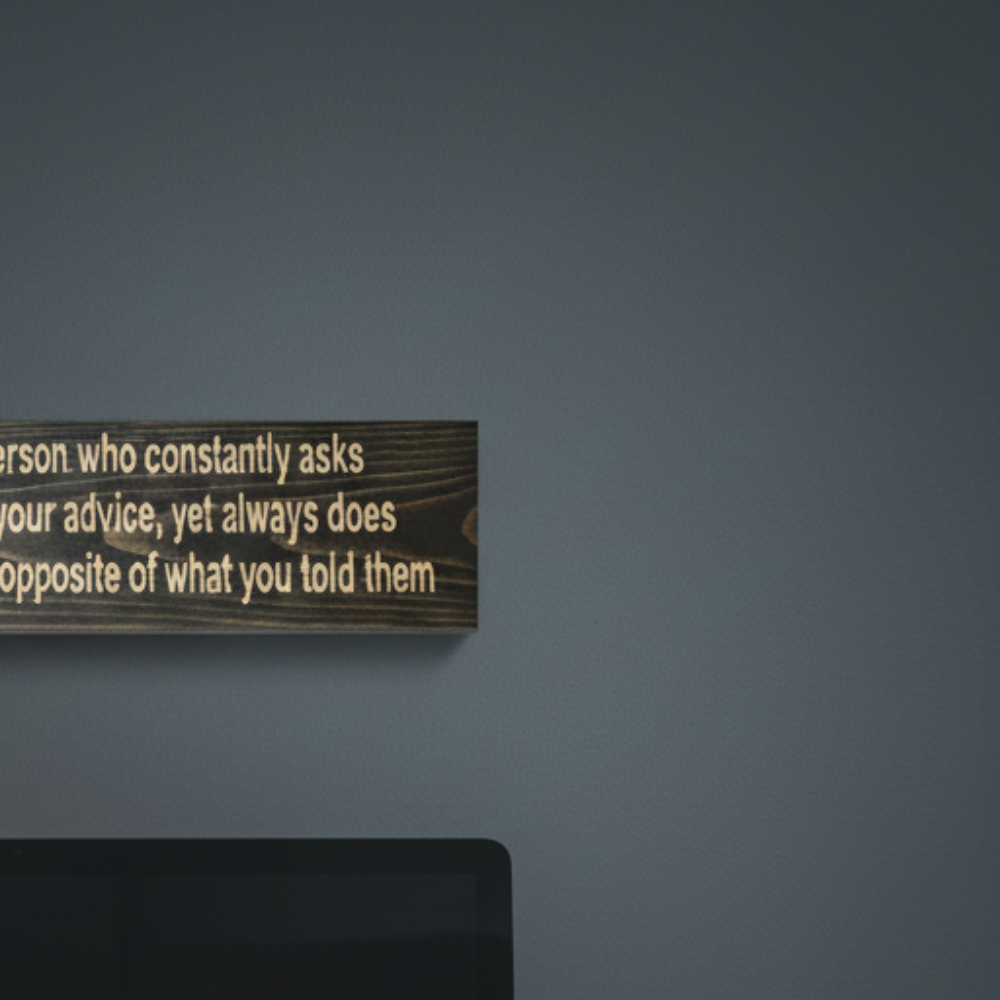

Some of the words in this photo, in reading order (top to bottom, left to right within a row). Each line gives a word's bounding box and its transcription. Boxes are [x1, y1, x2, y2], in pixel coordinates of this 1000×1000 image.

[77, 432, 138, 474] who
[144, 432, 291, 484] constantly
[298, 432, 364, 474] asks
[63, 491, 163, 539] advice,
[171, 494, 214, 544] yet
[222, 492, 318, 544] always
[327, 491, 397, 533] does
[128, 550, 160, 593] of
[164, 551, 233, 594] what
[240, 562, 292, 604] you
[300, 551, 355, 593] told
[364, 551, 434, 593] them
